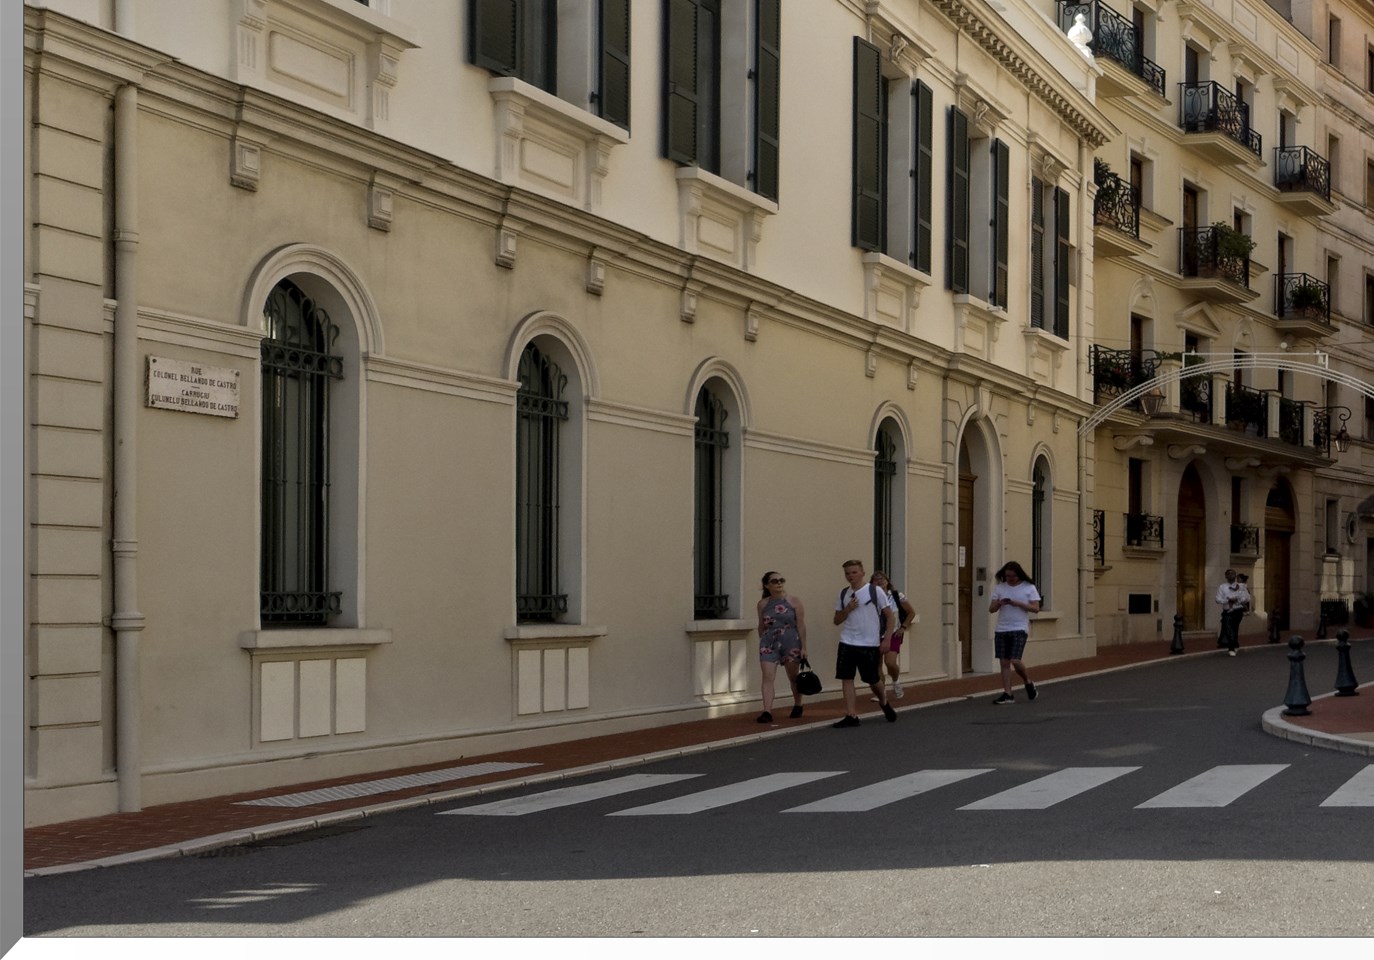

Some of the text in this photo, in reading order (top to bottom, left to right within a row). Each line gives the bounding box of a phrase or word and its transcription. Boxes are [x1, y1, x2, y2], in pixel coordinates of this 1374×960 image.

[153, 370, 237, 390] COLONEL BELLANDO DE CASTRO
[191, 367, 202, 375] RUE
[151, 394, 238, 413] CULUNELU BELLANDO DE CASTRO
